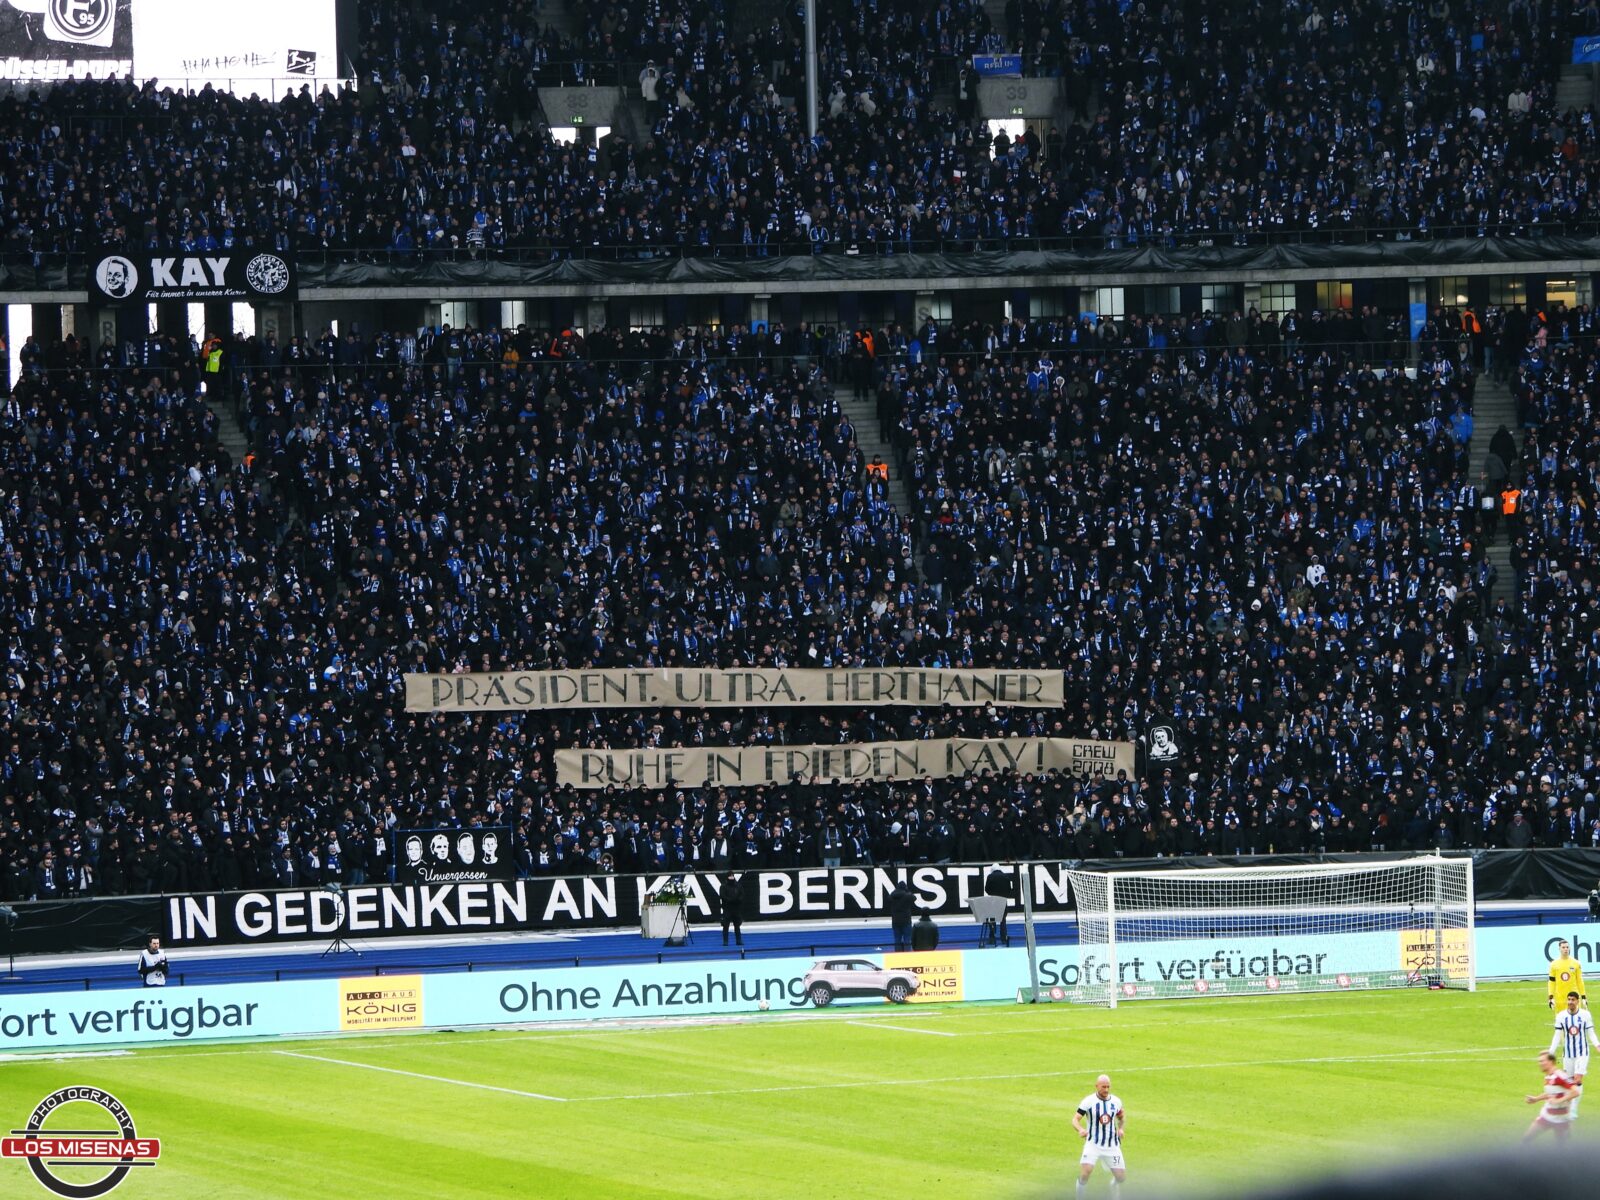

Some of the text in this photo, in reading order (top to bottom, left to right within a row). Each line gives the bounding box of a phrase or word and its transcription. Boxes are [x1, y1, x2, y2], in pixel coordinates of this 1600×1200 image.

[79, 13, 95, 25] 95
[0, 57, 132, 79] ÜSSELDORF
[1006, 86, 1027, 100] 39
[151, 257, 230, 287] KAY
[161, 290, 185, 298] immer
[187, 289, 194, 297] in
[432, 671, 1042, 706] PRÄSIDENT. ULTRA. HERTHANER
[1073, 744, 1116, 759] CREW
[581, 753, 685, 783] RUHE
[707, 752, 742, 782] IN
[765, 744, 926, 780] FRIEDEN.
[1073, 760, 1114, 775] 2008
[418, 867, 488, 881] Unvergessen
[170, 896, 217, 940] IN
[235, 881, 527, 937] GEDENKEN
[543, 877, 617, 921] AN
[1408, 943, 1468, 952] AUTOAUS
[1544, 935, 1600, 963] Oh
[1039, 948, 1328, 987] Sofort verfügbar
[499, 972, 809, 1012] Ohne Anzahlung
[0, 997, 259, 1038] ort verfügbar
[346, 1002, 417, 1016] KÖNIG
